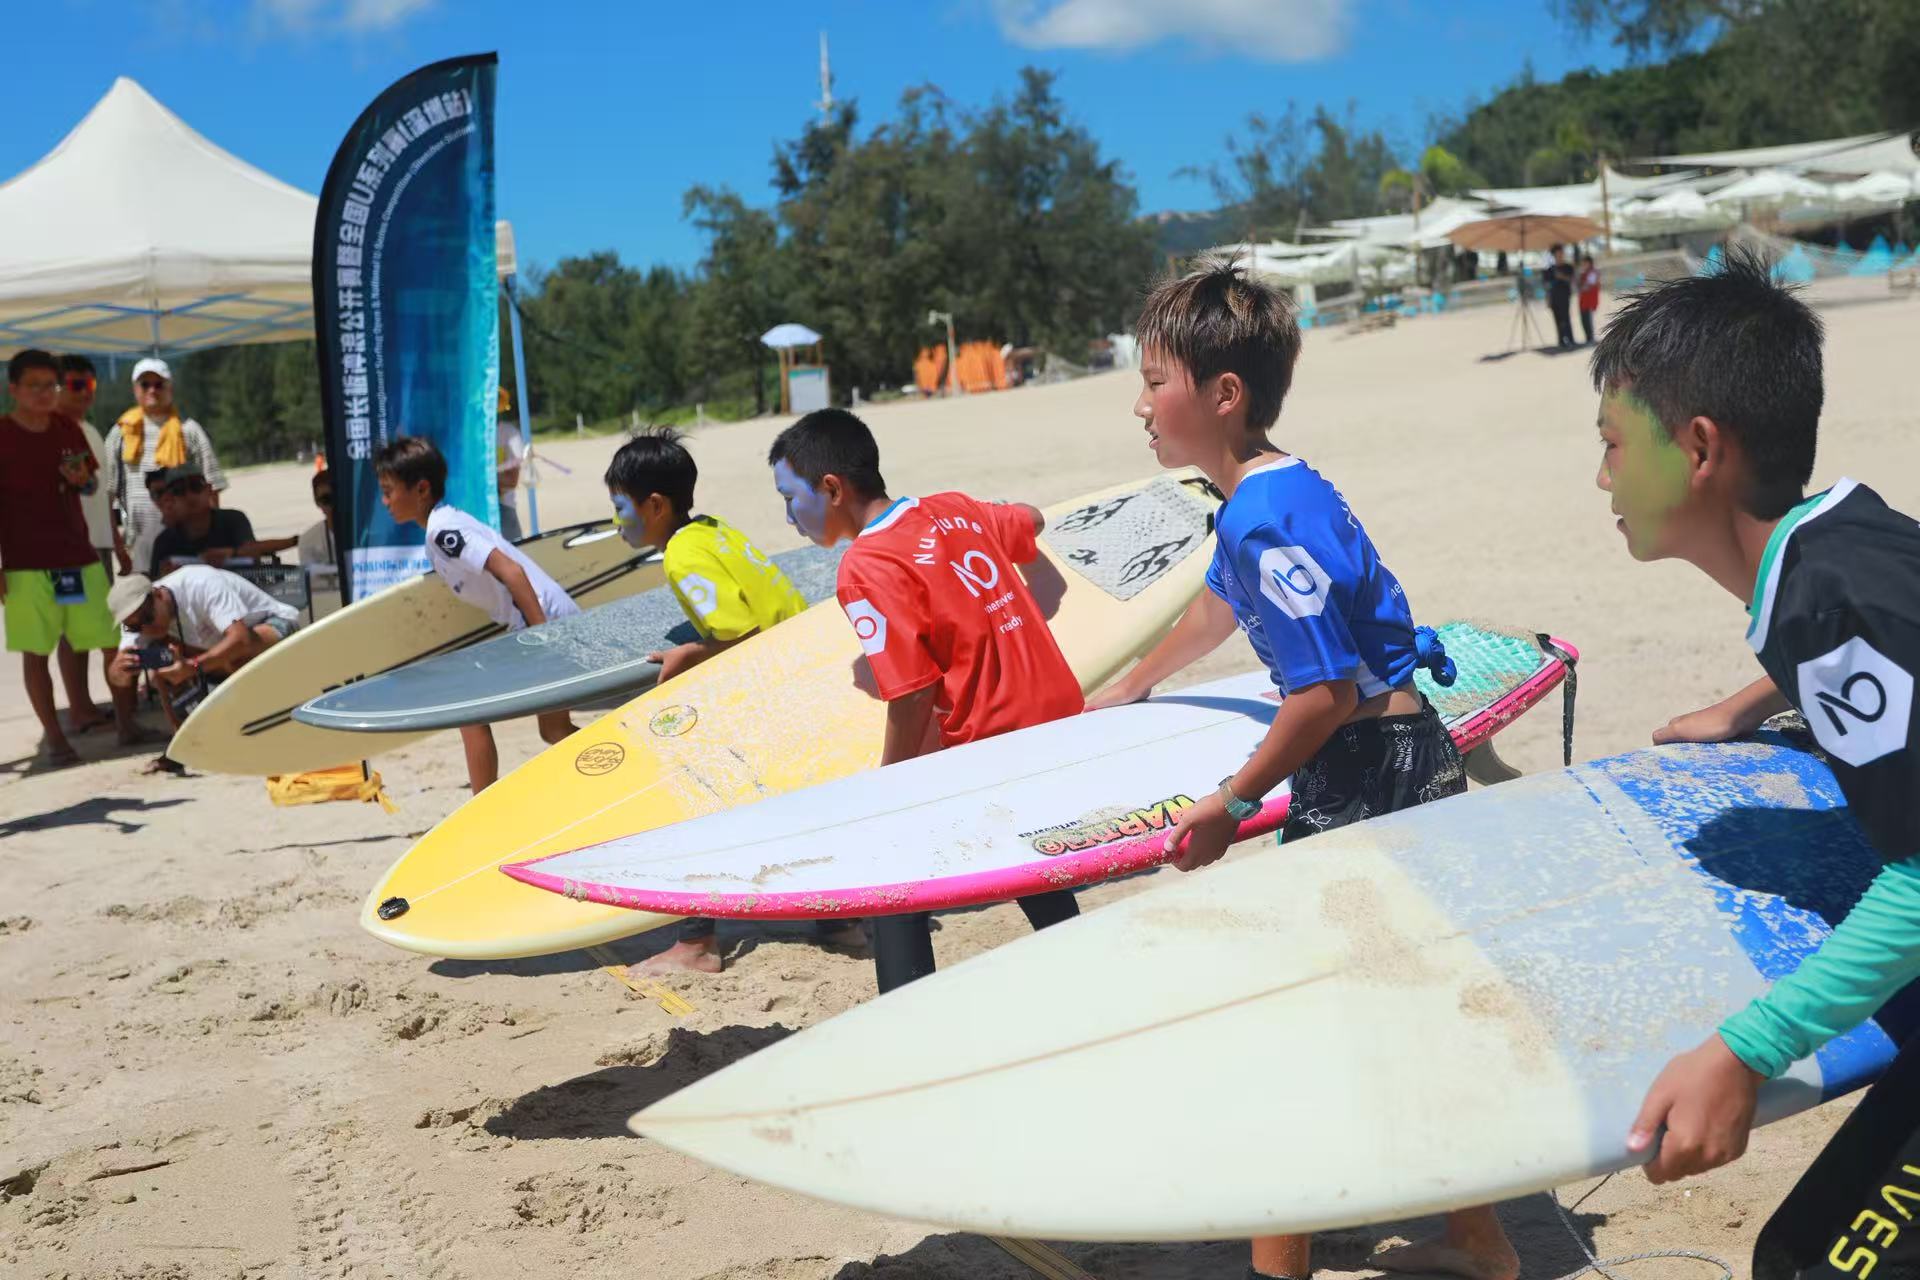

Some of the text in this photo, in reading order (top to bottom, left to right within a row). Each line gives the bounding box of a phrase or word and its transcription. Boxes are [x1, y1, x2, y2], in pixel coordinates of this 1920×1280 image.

[370, 261, 381, 299] National
[372, 310, 383, 334] Open
[374, 335, 385, 369] Surfing
[912, 515, 983, 565] Nu-june
[1828, 1164, 1920, 1280] VES
